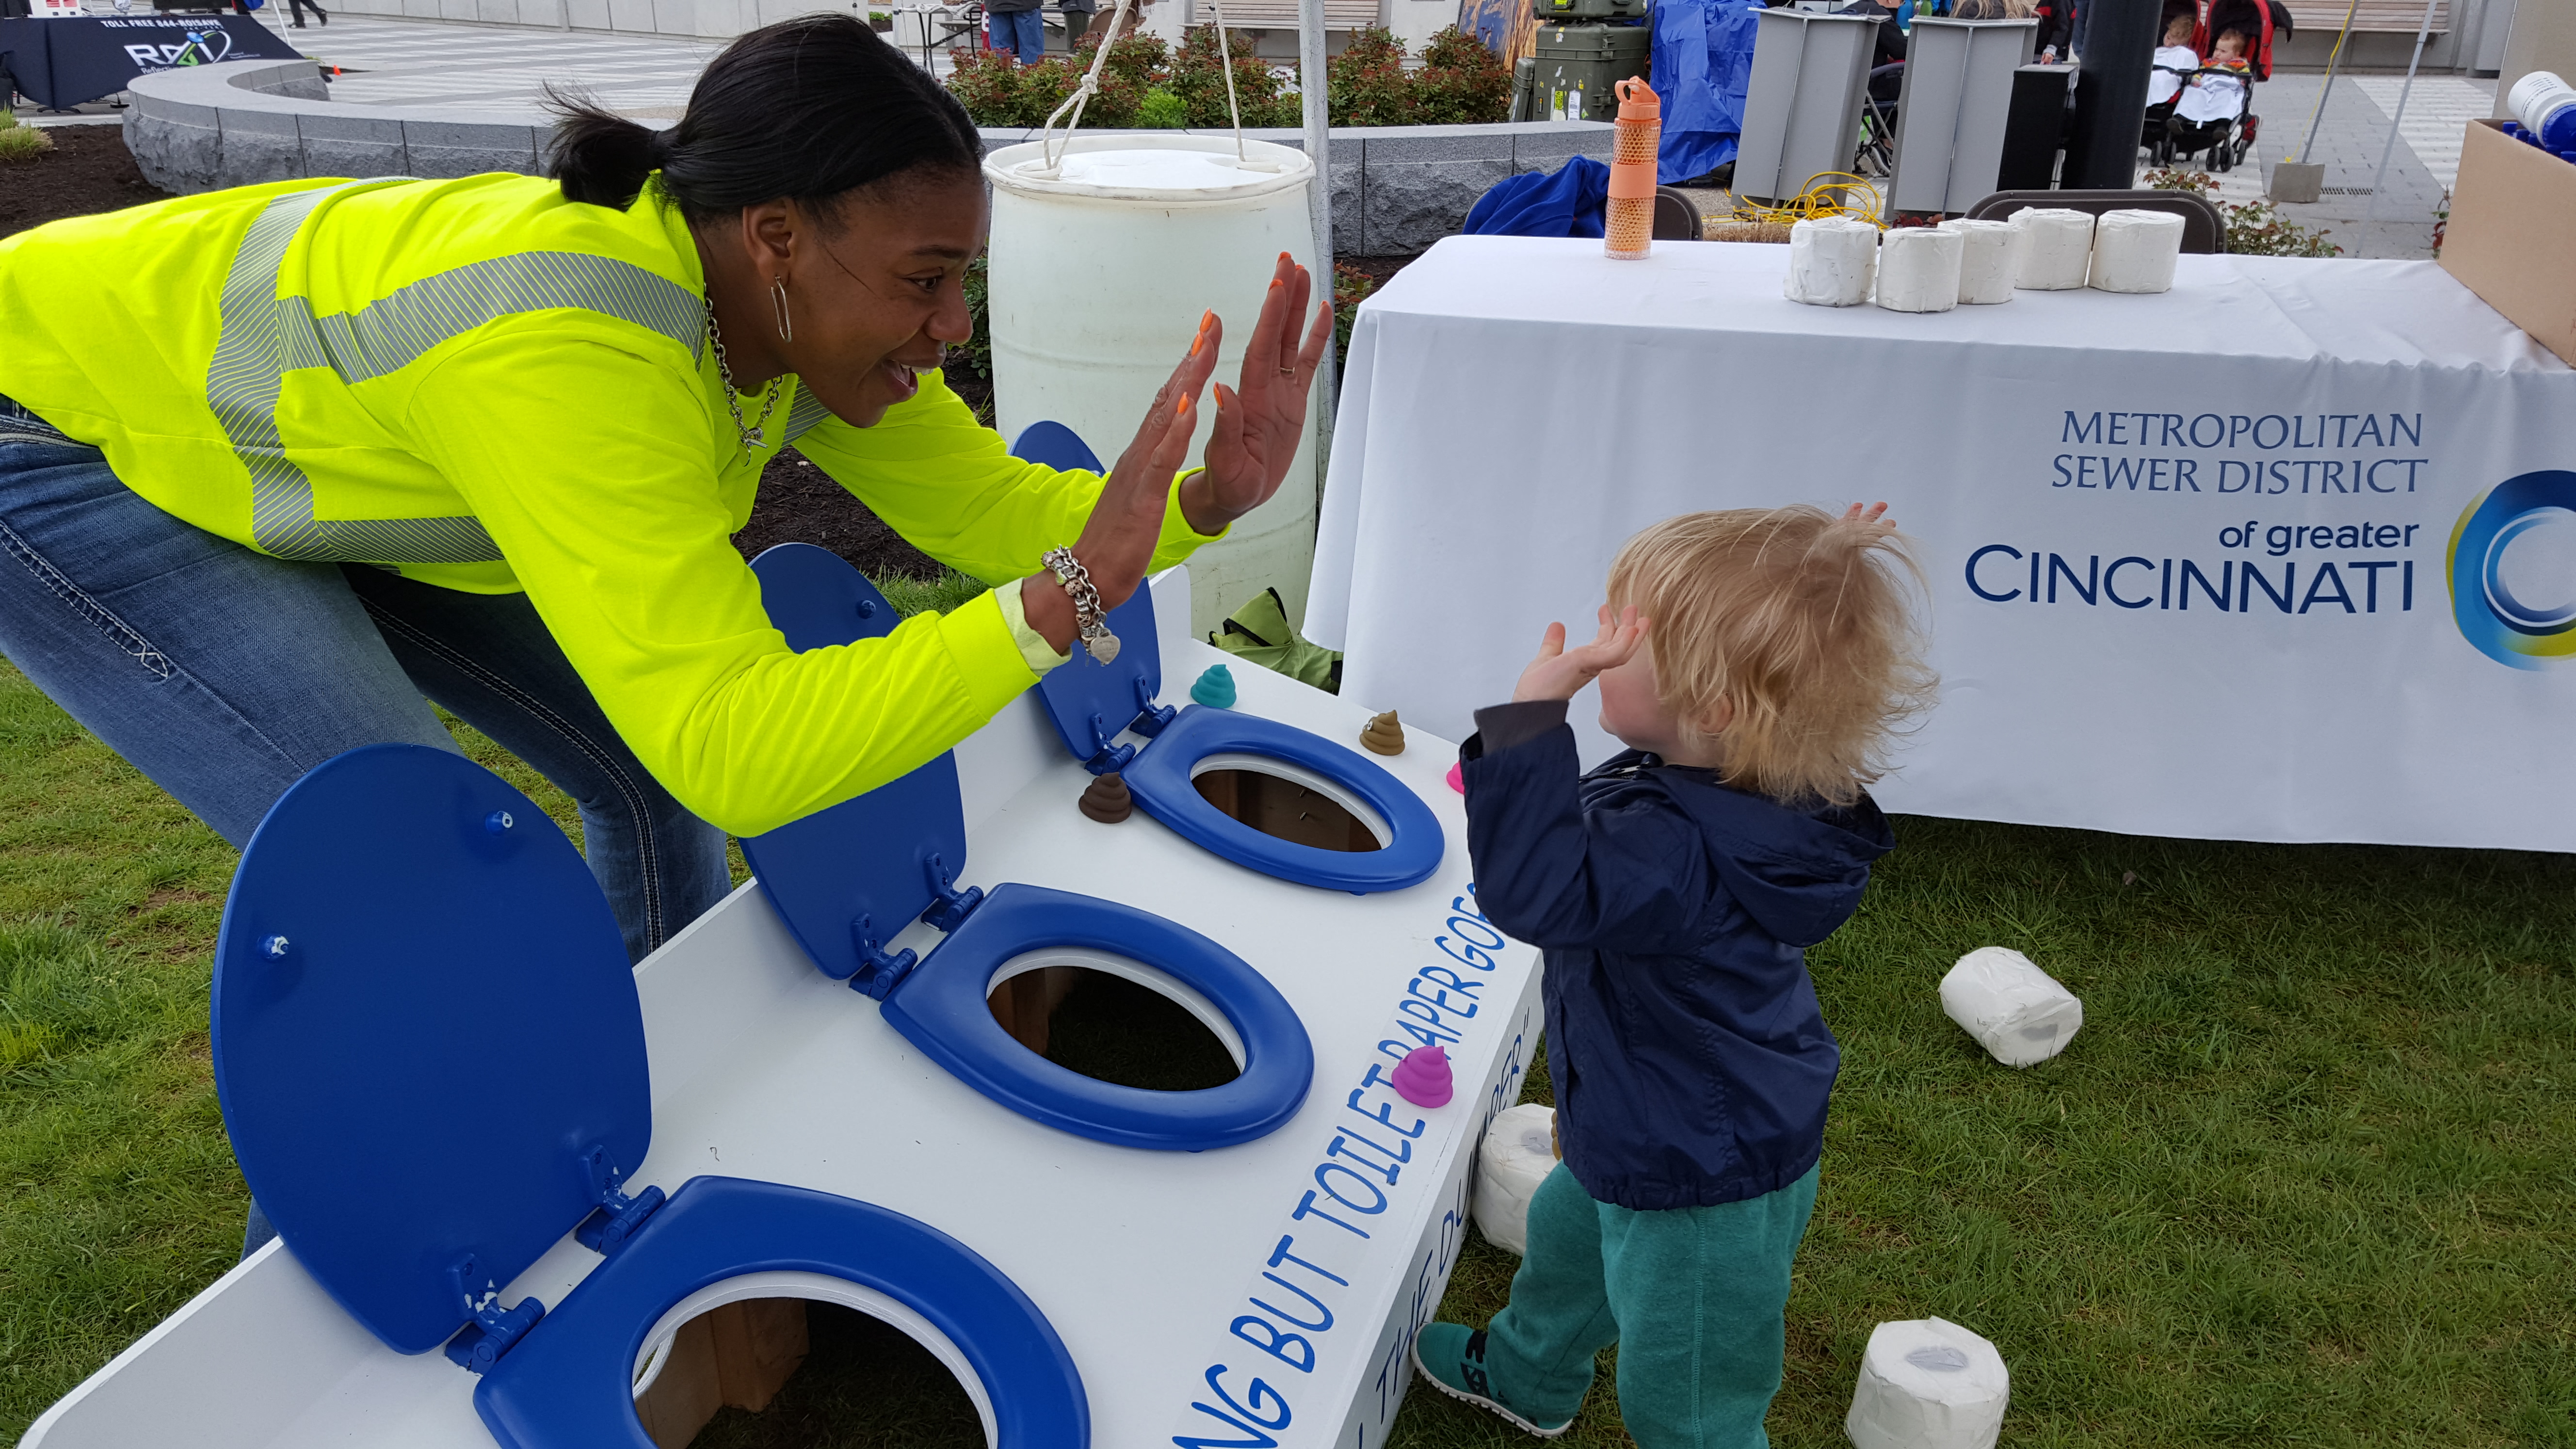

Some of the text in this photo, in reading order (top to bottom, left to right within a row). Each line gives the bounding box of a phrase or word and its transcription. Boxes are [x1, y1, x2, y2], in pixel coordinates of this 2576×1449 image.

[128, 19, 156, 28] FREE
[2061, 410, 2422, 450] METROPOLITAN
[2052, 454, 2429, 495] SEWER DISTRICT
[2219, 520, 2420, 557] of greater
[1965, 544, 2413, 614] CINCINNATI
[1229, 1235, 1349, 1373] BUT
[1292, 1063, 1425, 1239] TOILET
[1376, 1249, 1433, 1425] THE
